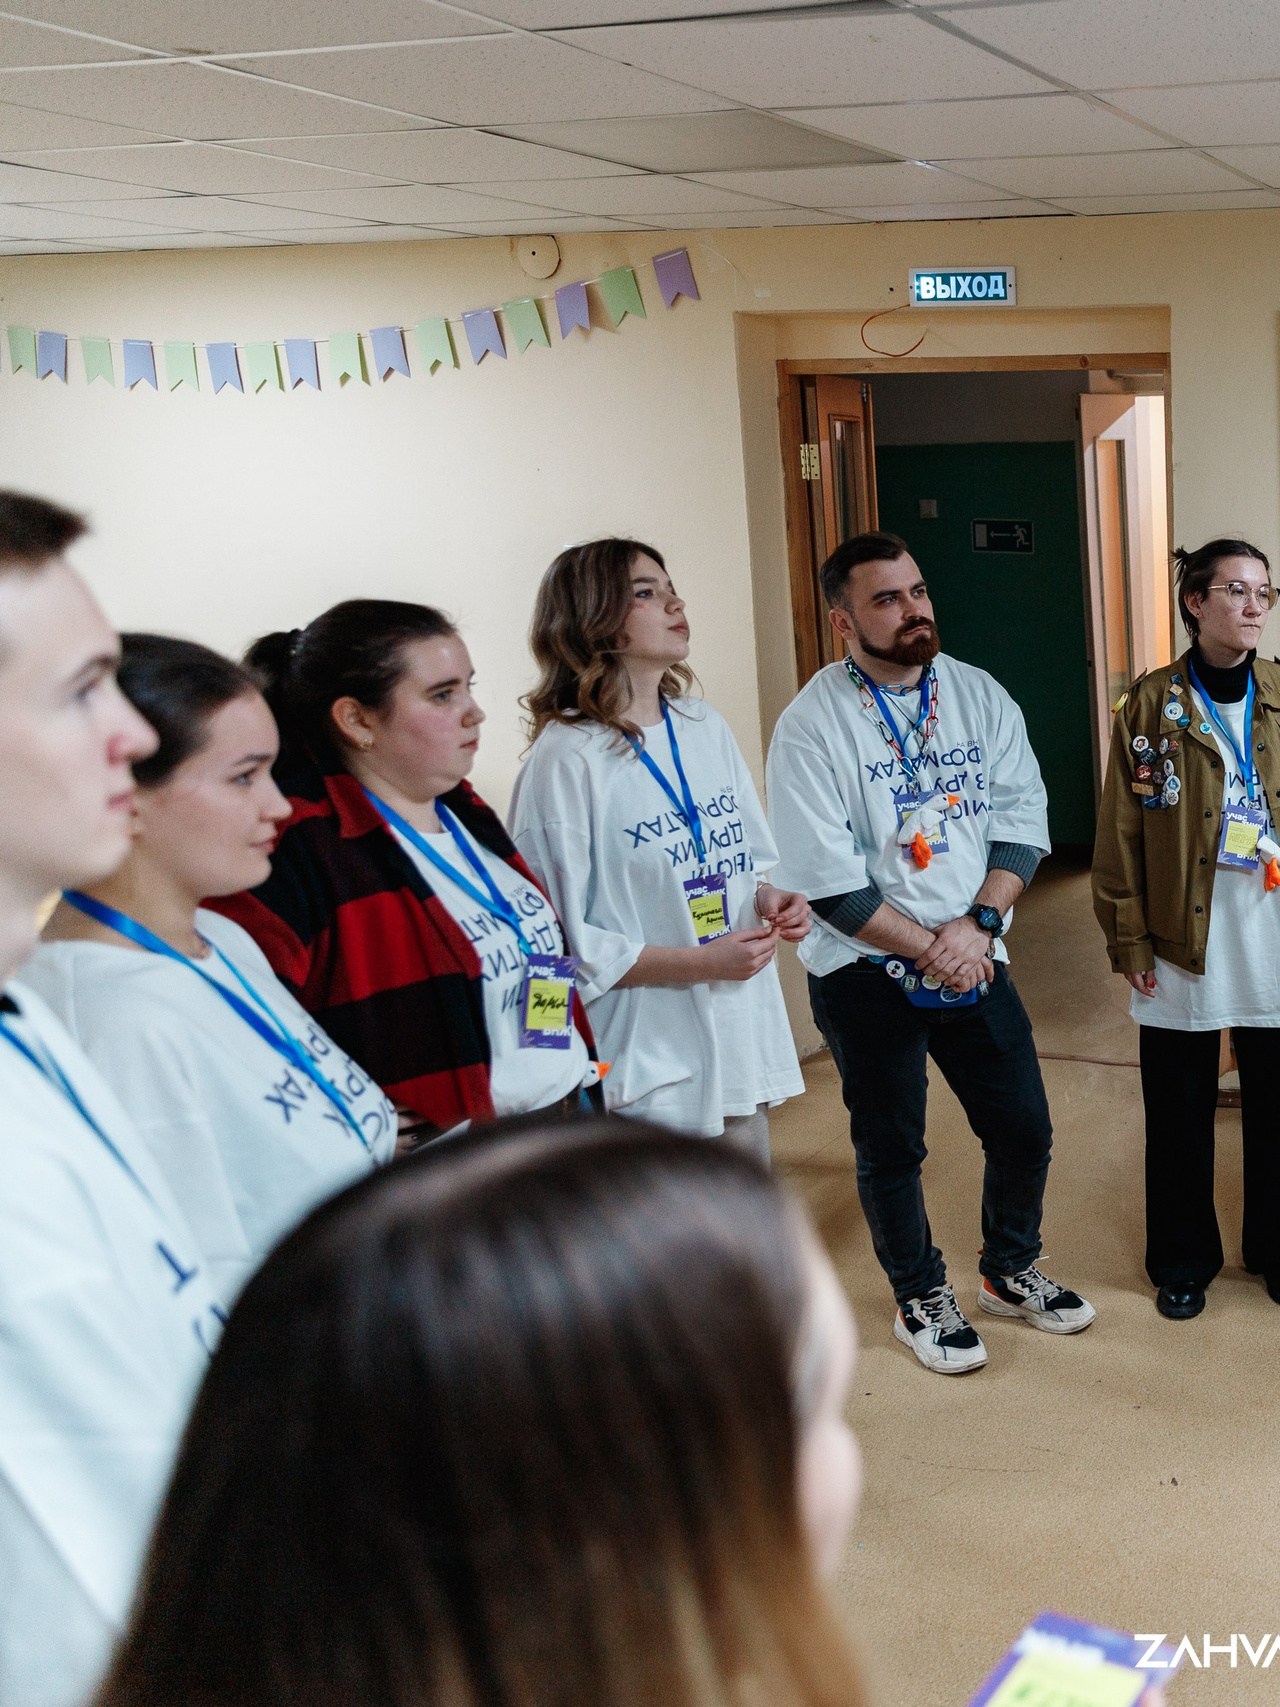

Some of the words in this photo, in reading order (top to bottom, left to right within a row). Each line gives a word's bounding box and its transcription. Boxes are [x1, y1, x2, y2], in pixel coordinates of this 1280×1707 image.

[919, 275, 1005, 299] ВЫХОД
[1226, 811, 1248, 822] учас
[527, 965, 556, 978] учас
